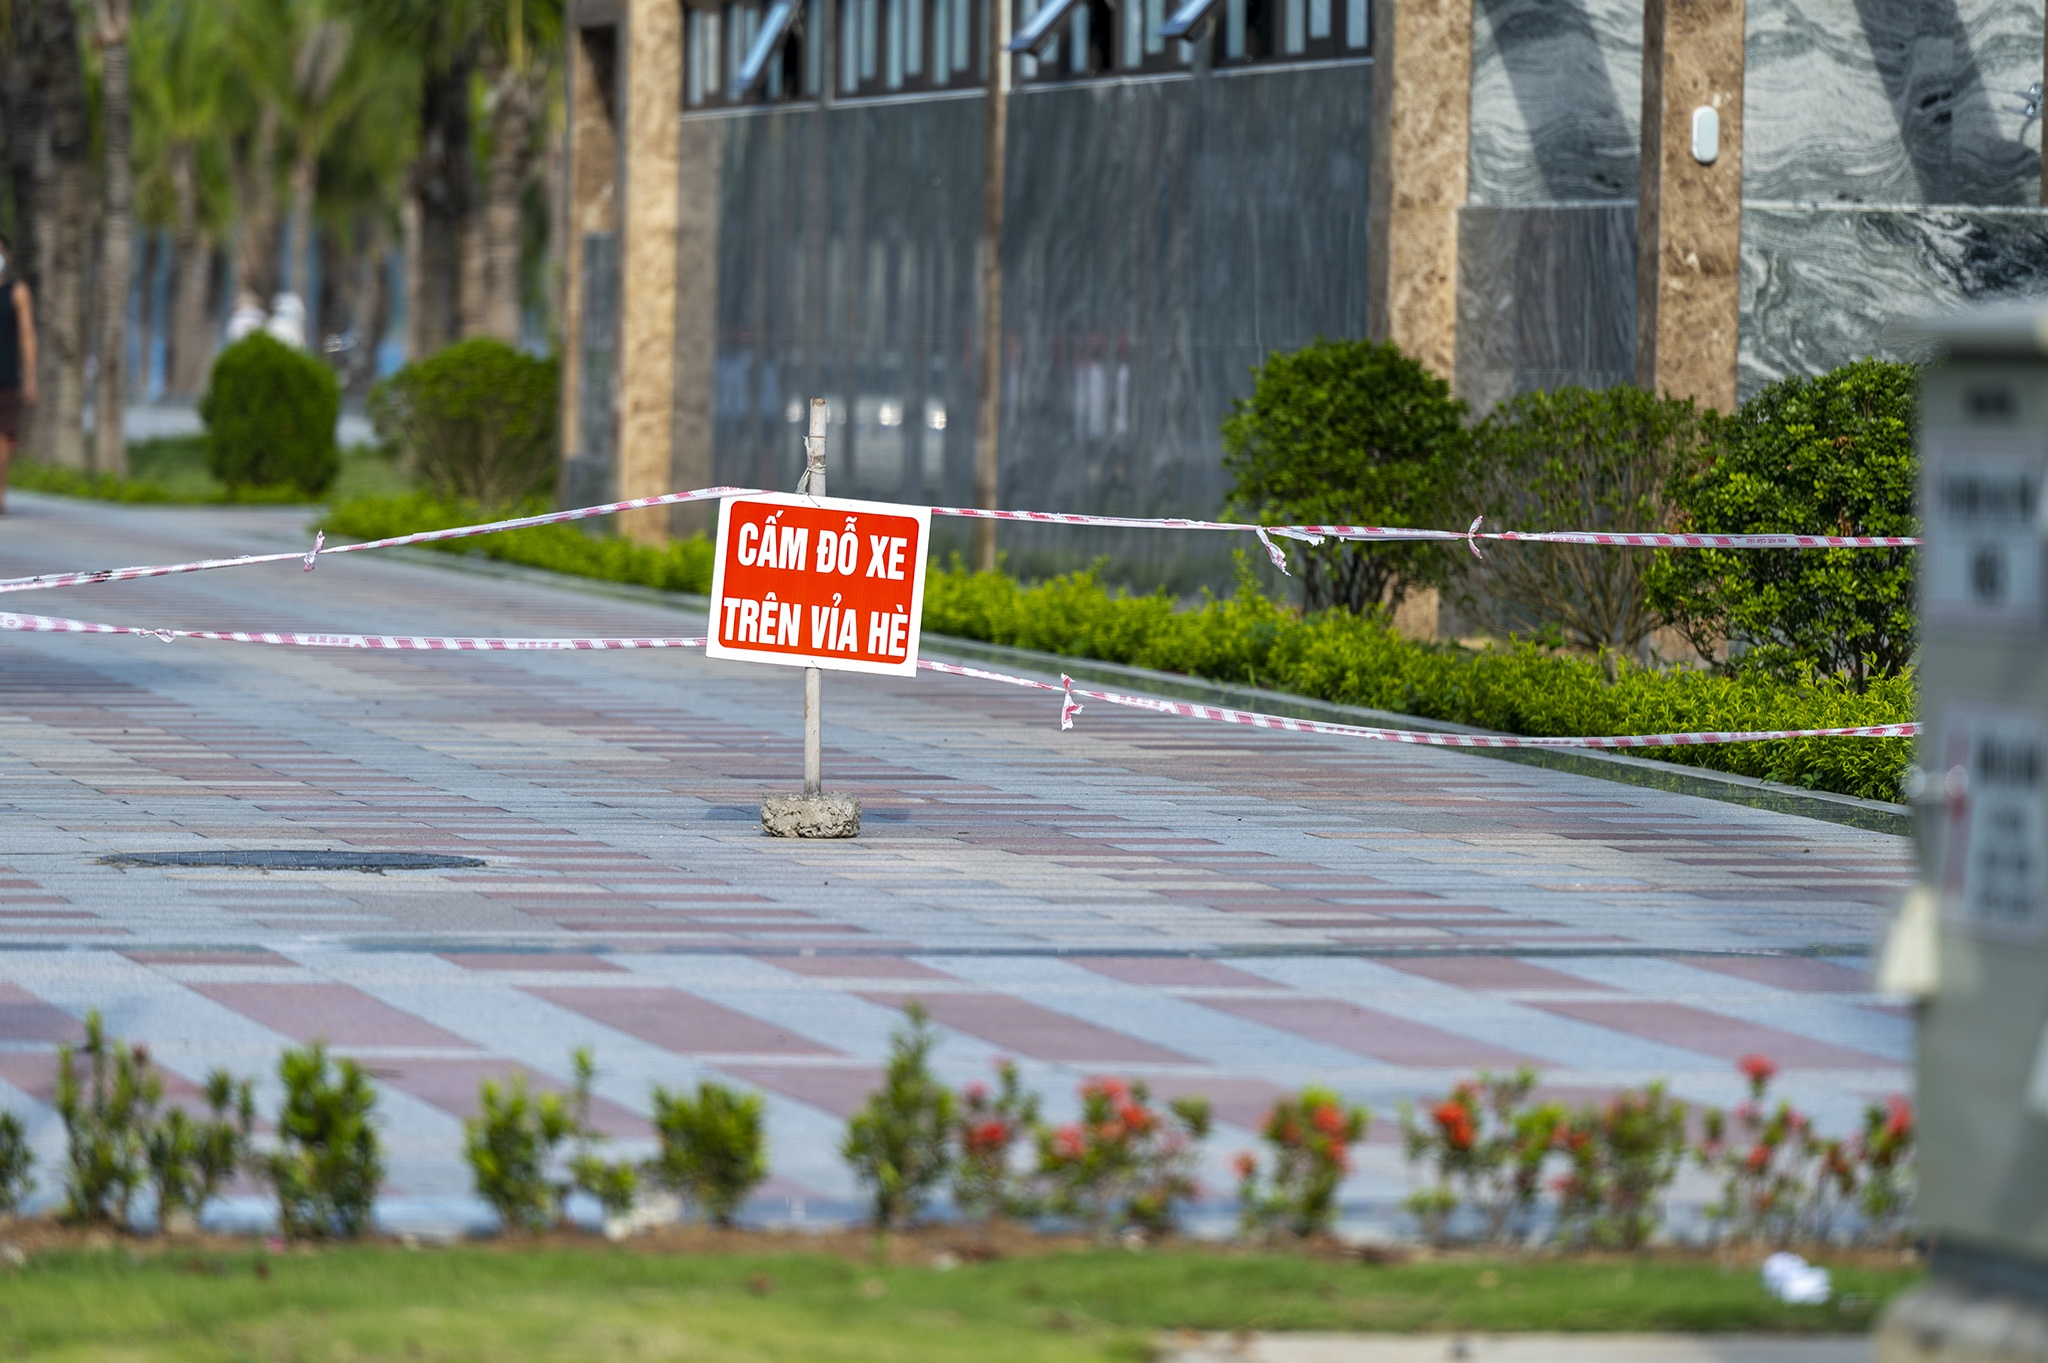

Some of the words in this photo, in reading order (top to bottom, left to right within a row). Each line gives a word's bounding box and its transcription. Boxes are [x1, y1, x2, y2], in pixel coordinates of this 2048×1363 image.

[737, 510, 809, 571] CẤM
[816, 516, 859, 576] ĐỖ
[865, 534, 907, 581] XE
[723, 591, 802, 647] TRÊN
[811, 592, 857, 653] VỈA
[867, 604, 908, 657] HÈ
